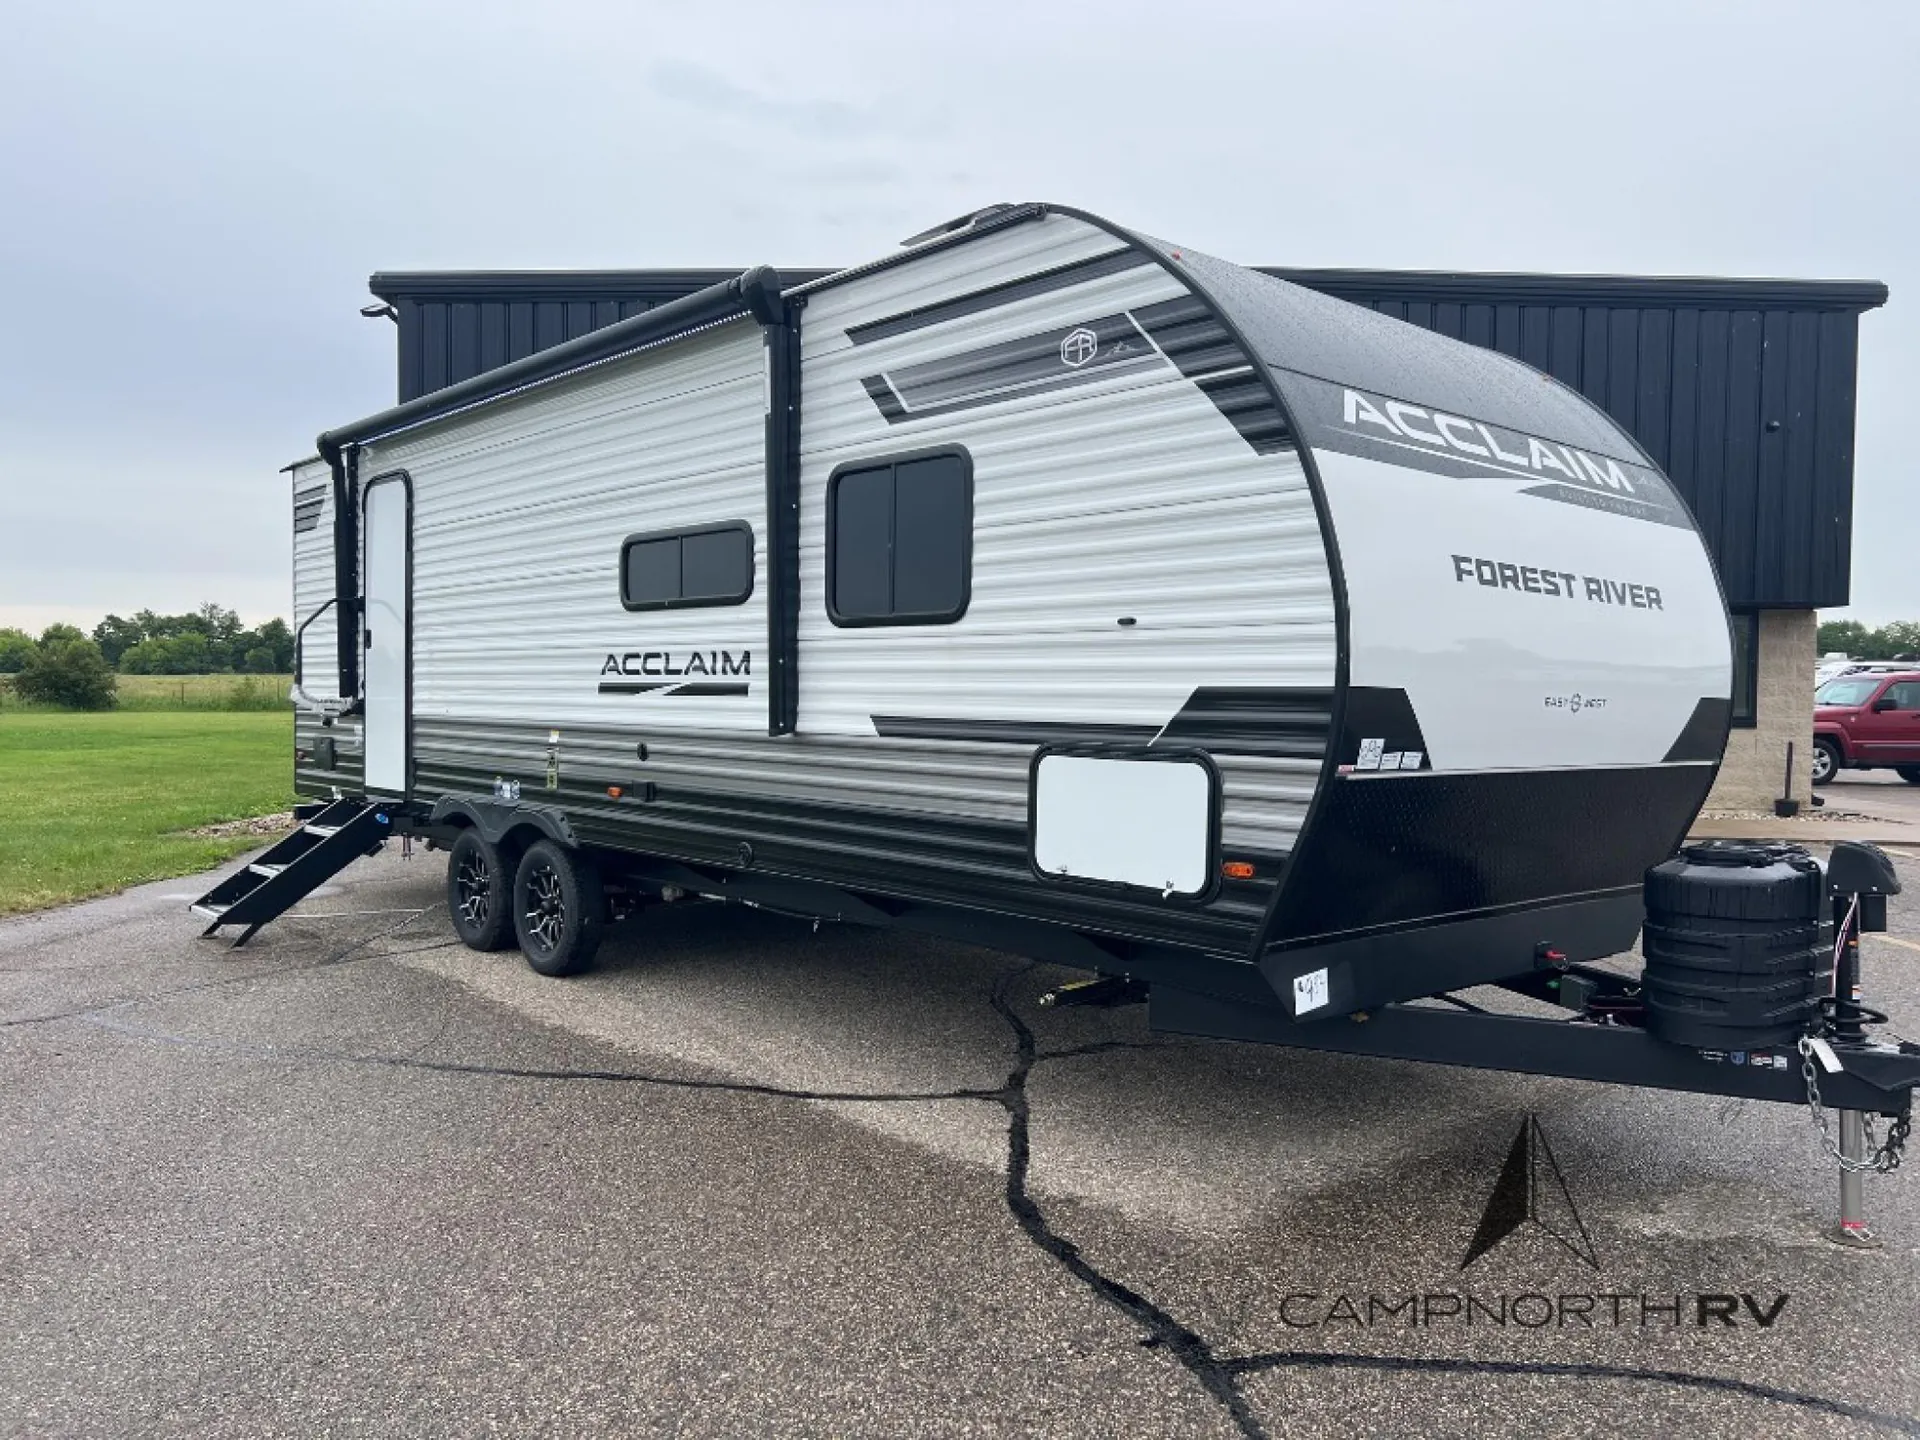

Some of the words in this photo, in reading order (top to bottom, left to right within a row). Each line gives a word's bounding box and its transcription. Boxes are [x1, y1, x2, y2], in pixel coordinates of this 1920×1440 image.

[1343, 389, 1635, 494] ACCLAIM
[1451, 554, 1577, 600] FOREST
[1584, 576, 1664, 611] RIVER
[600, 650, 750, 676] ACCLAIM
